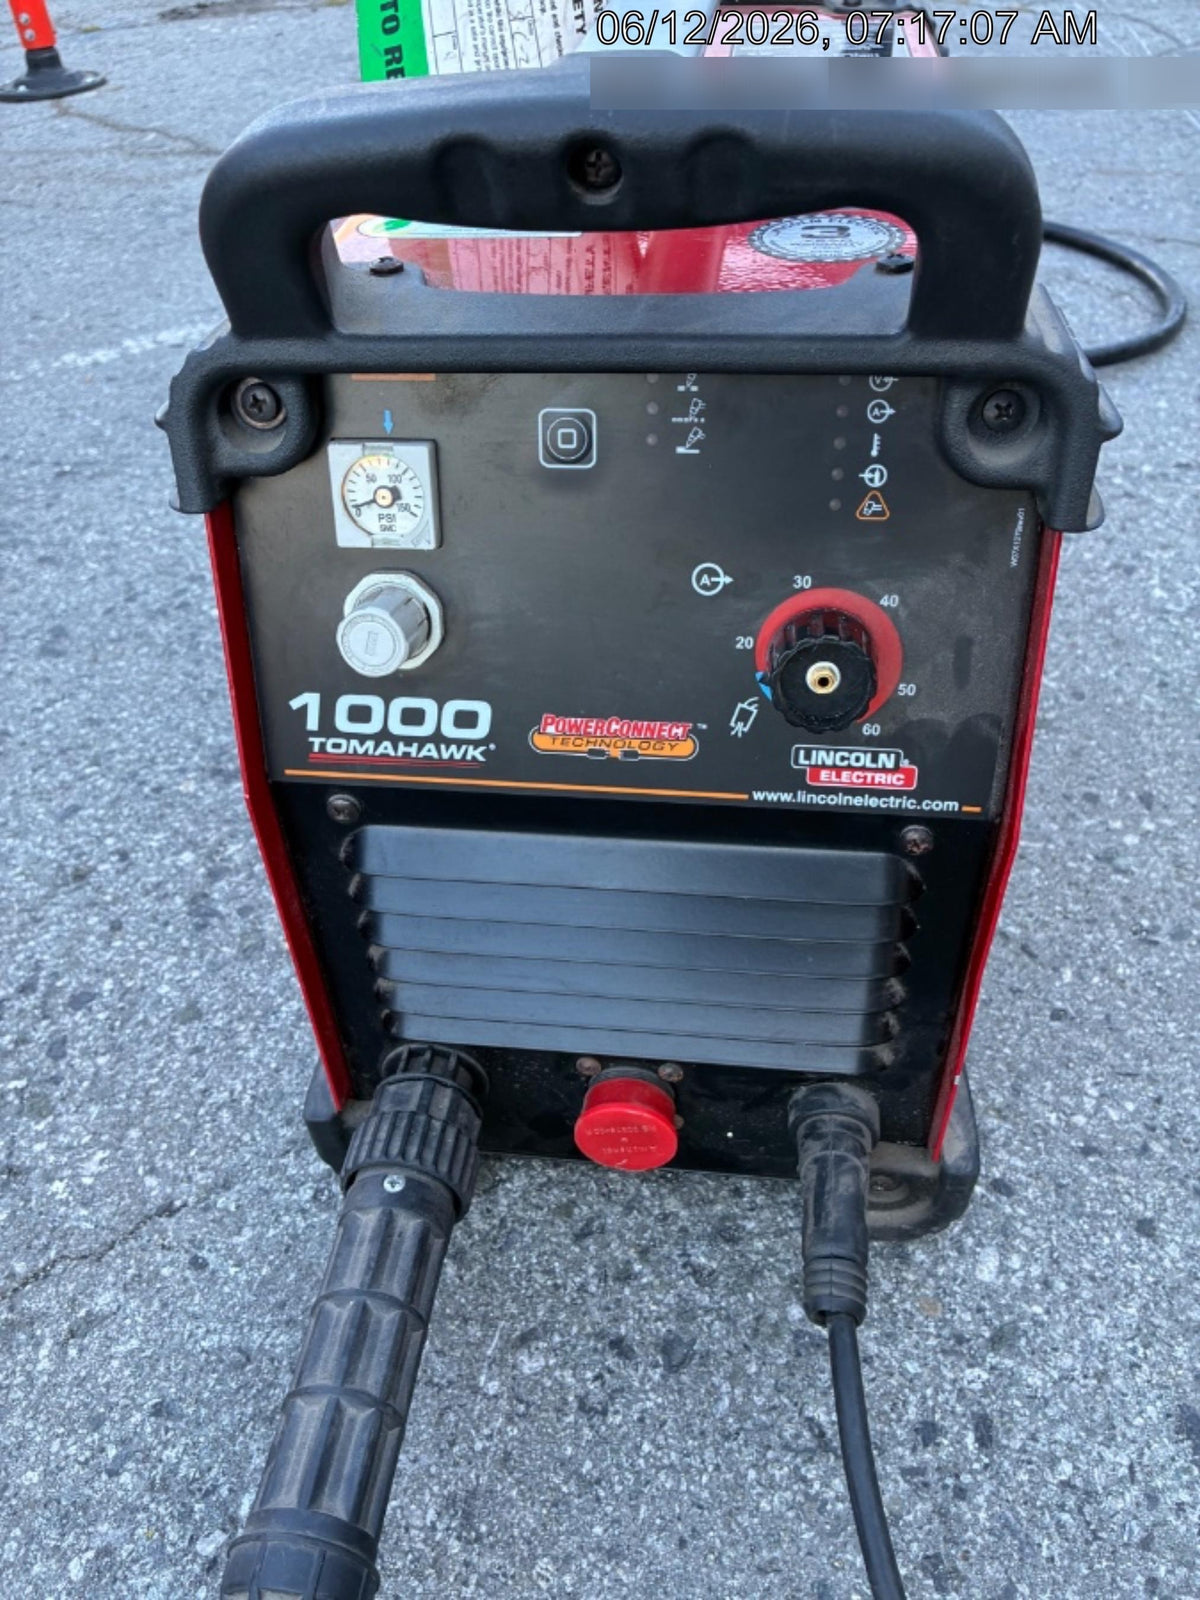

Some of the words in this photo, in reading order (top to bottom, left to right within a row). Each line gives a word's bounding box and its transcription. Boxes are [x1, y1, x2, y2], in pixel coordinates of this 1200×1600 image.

[380, 0, 400, 36] TO
[365, 473, 377, 483] 50
[387, 474, 402, 484] 100
[396, 502, 411, 512] 150
[378, 513, 397, 523] PSI
[793, 575, 812, 589] 30
[879, 594, 899, 607] 40
[735, 636, 754, 650] 20
[897, 683, 916, 697] 50
[289, 692, 492, 740] 1000
[862, 723, 881, 736] 60
[308, 736, 487, 763] TOMAHAWK
[550, 736, 680, 752] TECHNOLOGY
[798, 750, 896, 769] LINCOLN
[819, 769, 906, 786] ELECTRIC
[752, 788, 960, 812] www.lincolnelectric.com
